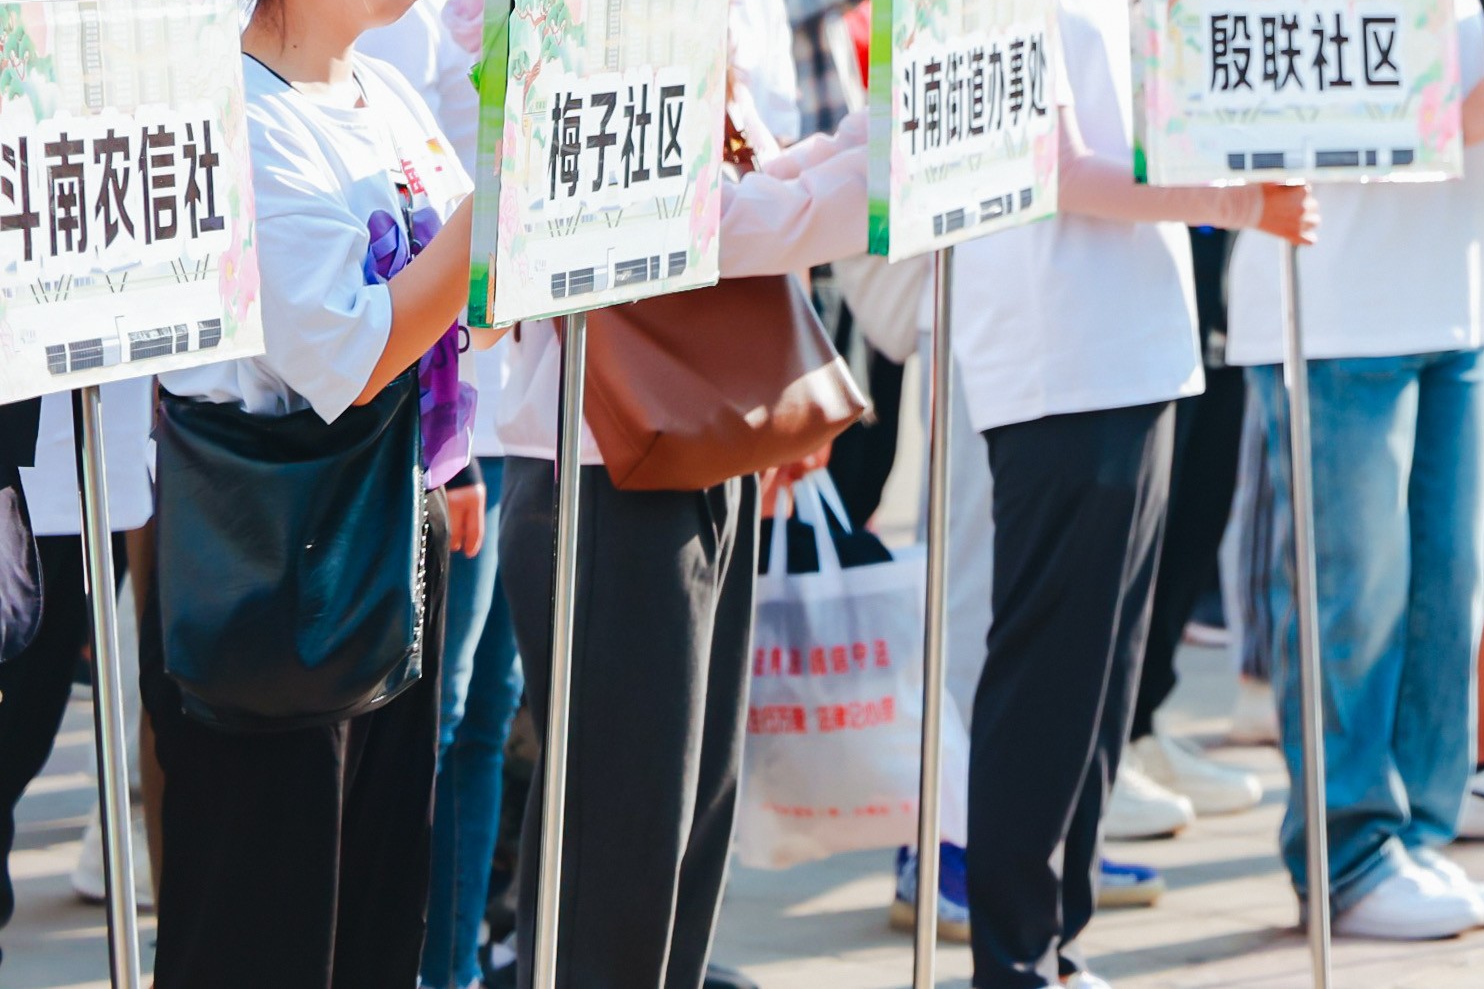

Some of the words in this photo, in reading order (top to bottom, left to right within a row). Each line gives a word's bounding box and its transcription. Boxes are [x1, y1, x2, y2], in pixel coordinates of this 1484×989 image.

[903, 33, 1046, 155] 斗南街道办事处
[1210, 13, 1402, 91] 殷联社区
[0, 120, 225, 262] 斗南农信社
[547, 83, 686, 200] 梅子社区
